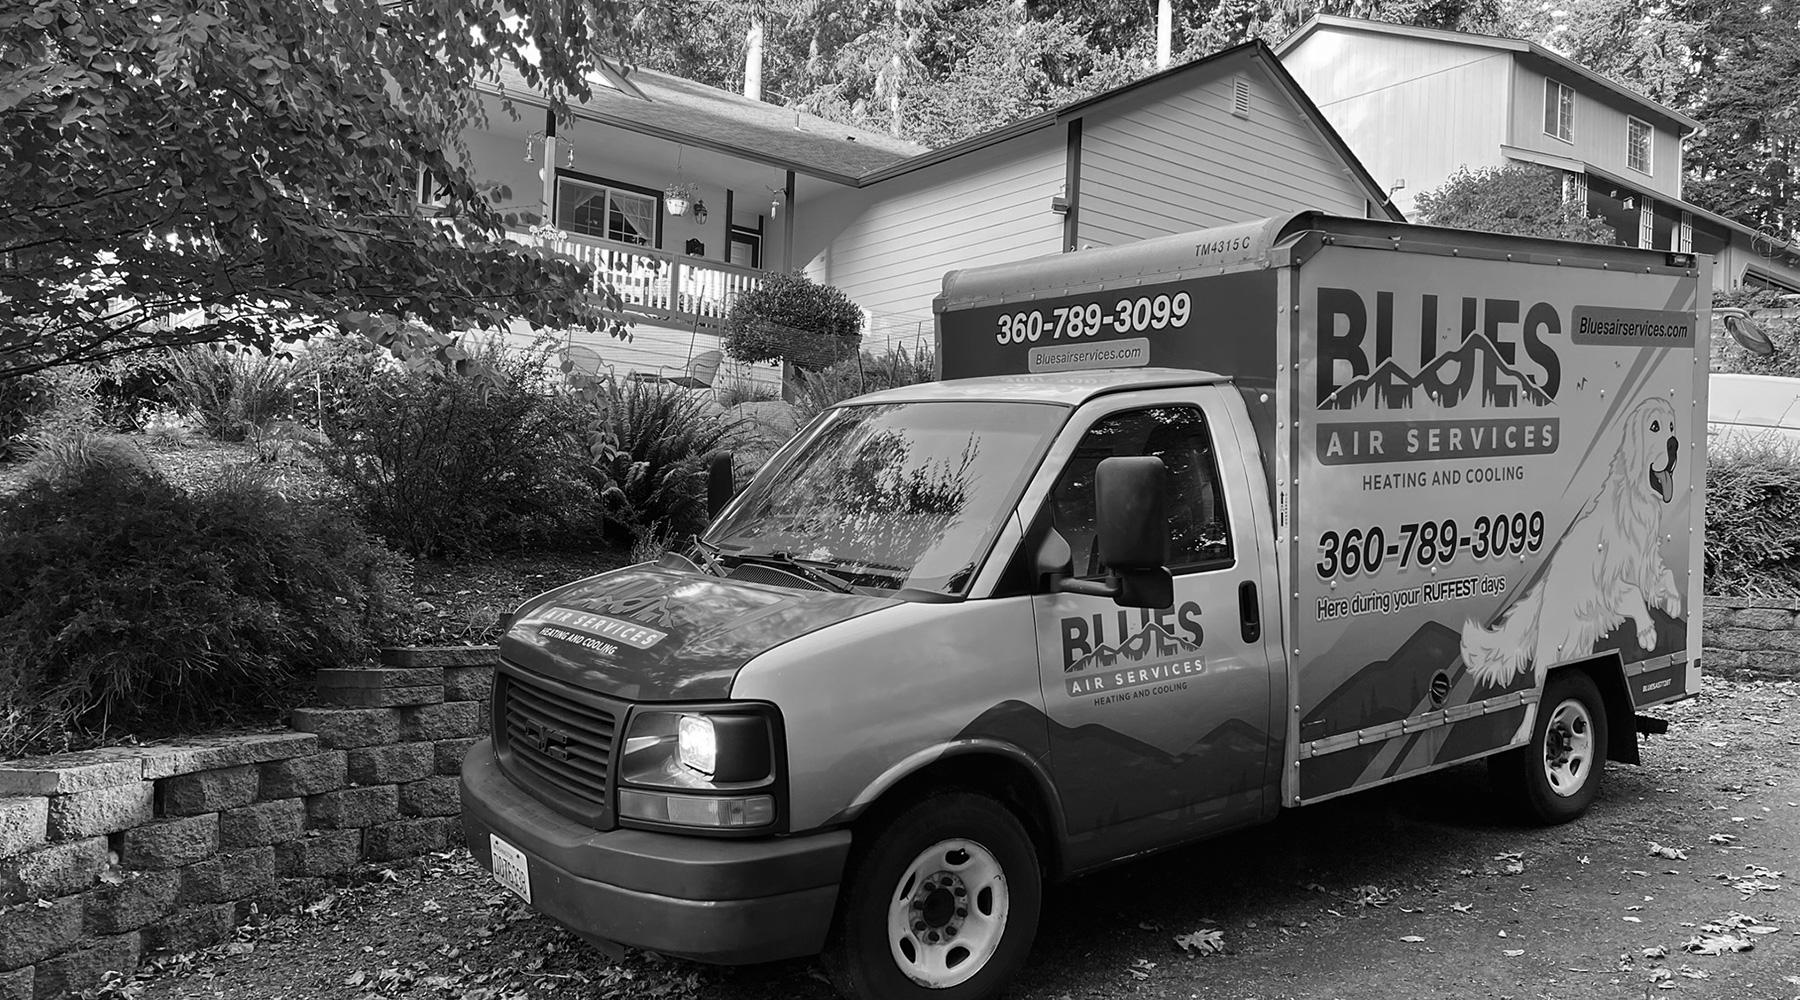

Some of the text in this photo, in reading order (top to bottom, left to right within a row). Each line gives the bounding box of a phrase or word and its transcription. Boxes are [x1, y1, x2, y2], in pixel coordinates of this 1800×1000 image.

[995, 291, 1193, 346] 360-789-3099
[1579, 317, 1688, 339] Bluesairservices.com
[1035, 345, 1141, 366] Bluesairservices.com
[1316, 287, 1562, 411] BLUES
[1326, 425, 1553, 457] AIR SERVICES
[1362, 466, 1524, 491] HEATING AND COOLING
[1316, 510, 1545, 580] 360-789-3099
[1317, 576, 1506, 619] Here during your RUFFEST days
[539, 626, 618, 655] HEATING AND COOLING
[543, 610, 658, 645] AIR SERVICES
[1061, 601, 1204, 673] BLUES
[1072, 659, 1203, 694] AIR SERVICES
[1094, 682, 1188, 706] HEATING AND COOLING
